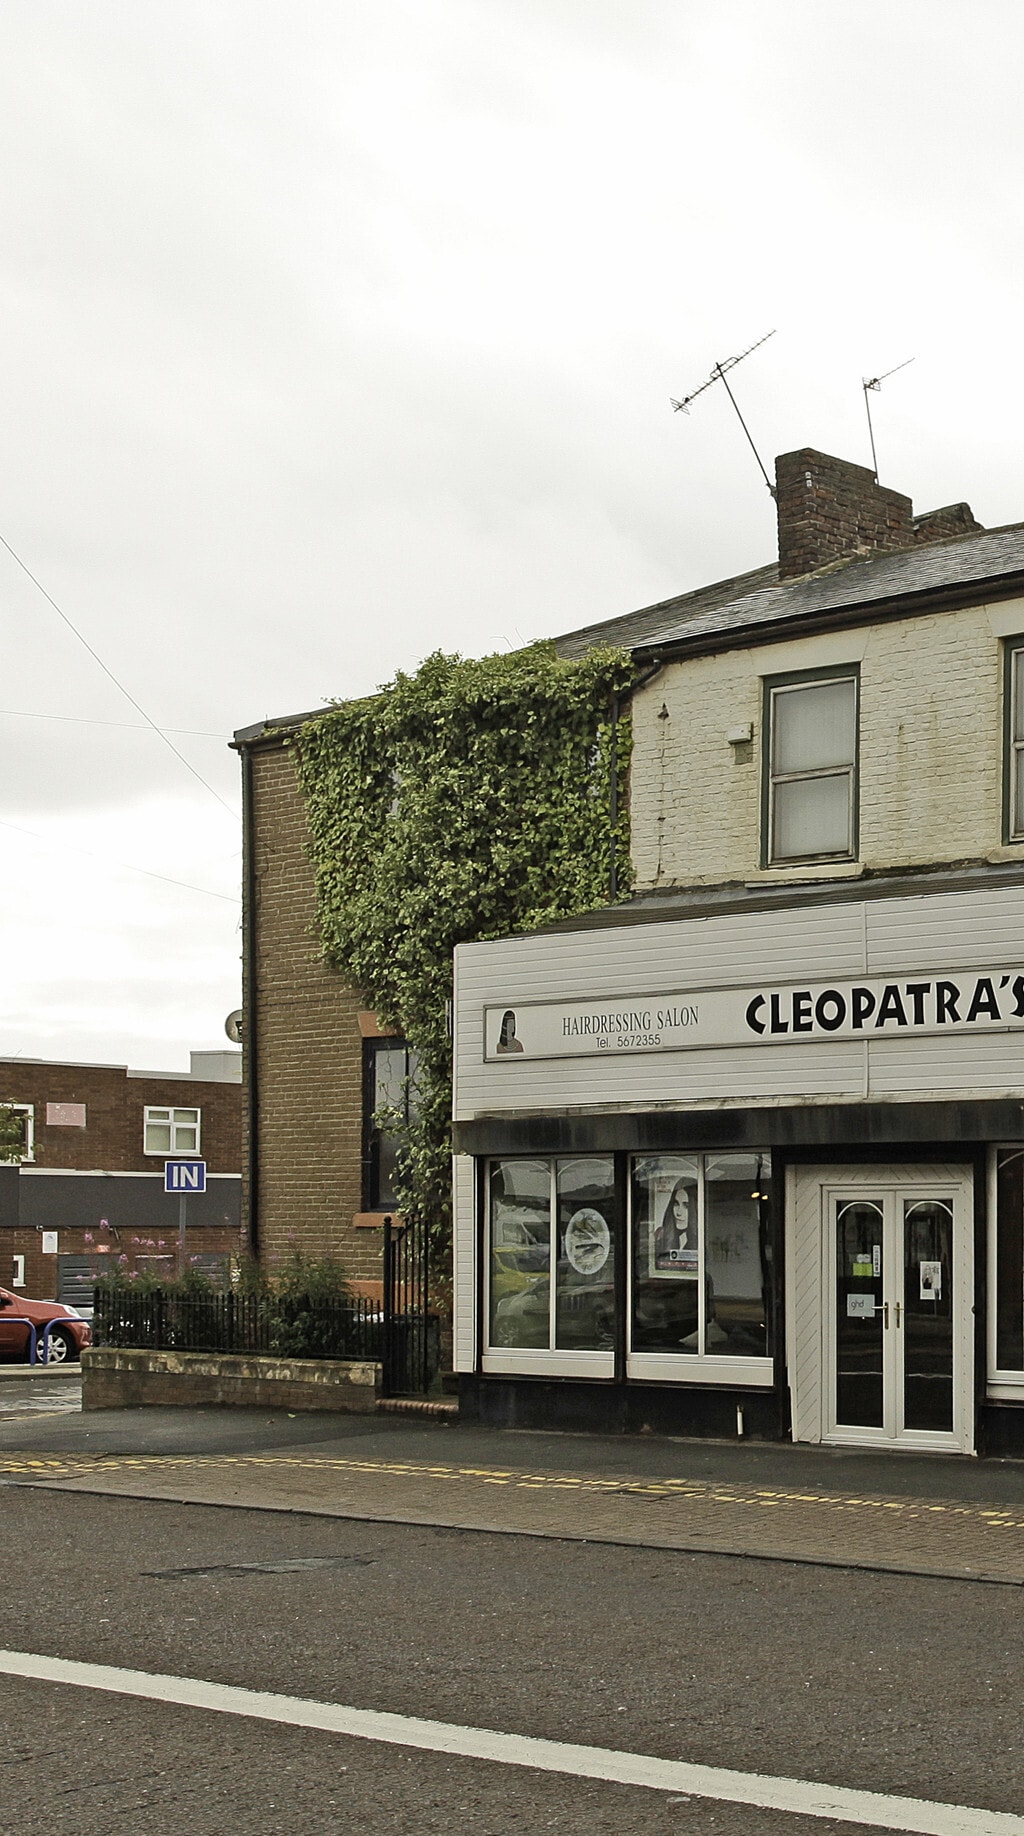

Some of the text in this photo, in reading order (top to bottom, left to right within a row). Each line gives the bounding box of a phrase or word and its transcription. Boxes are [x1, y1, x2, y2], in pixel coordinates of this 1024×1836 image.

[562, 1006, 699, 1036] HAIRDRESSING SALON
[596, 1034, 661, 1048] Tel. 5672355
[173, 1166, 198, 1187] IN
